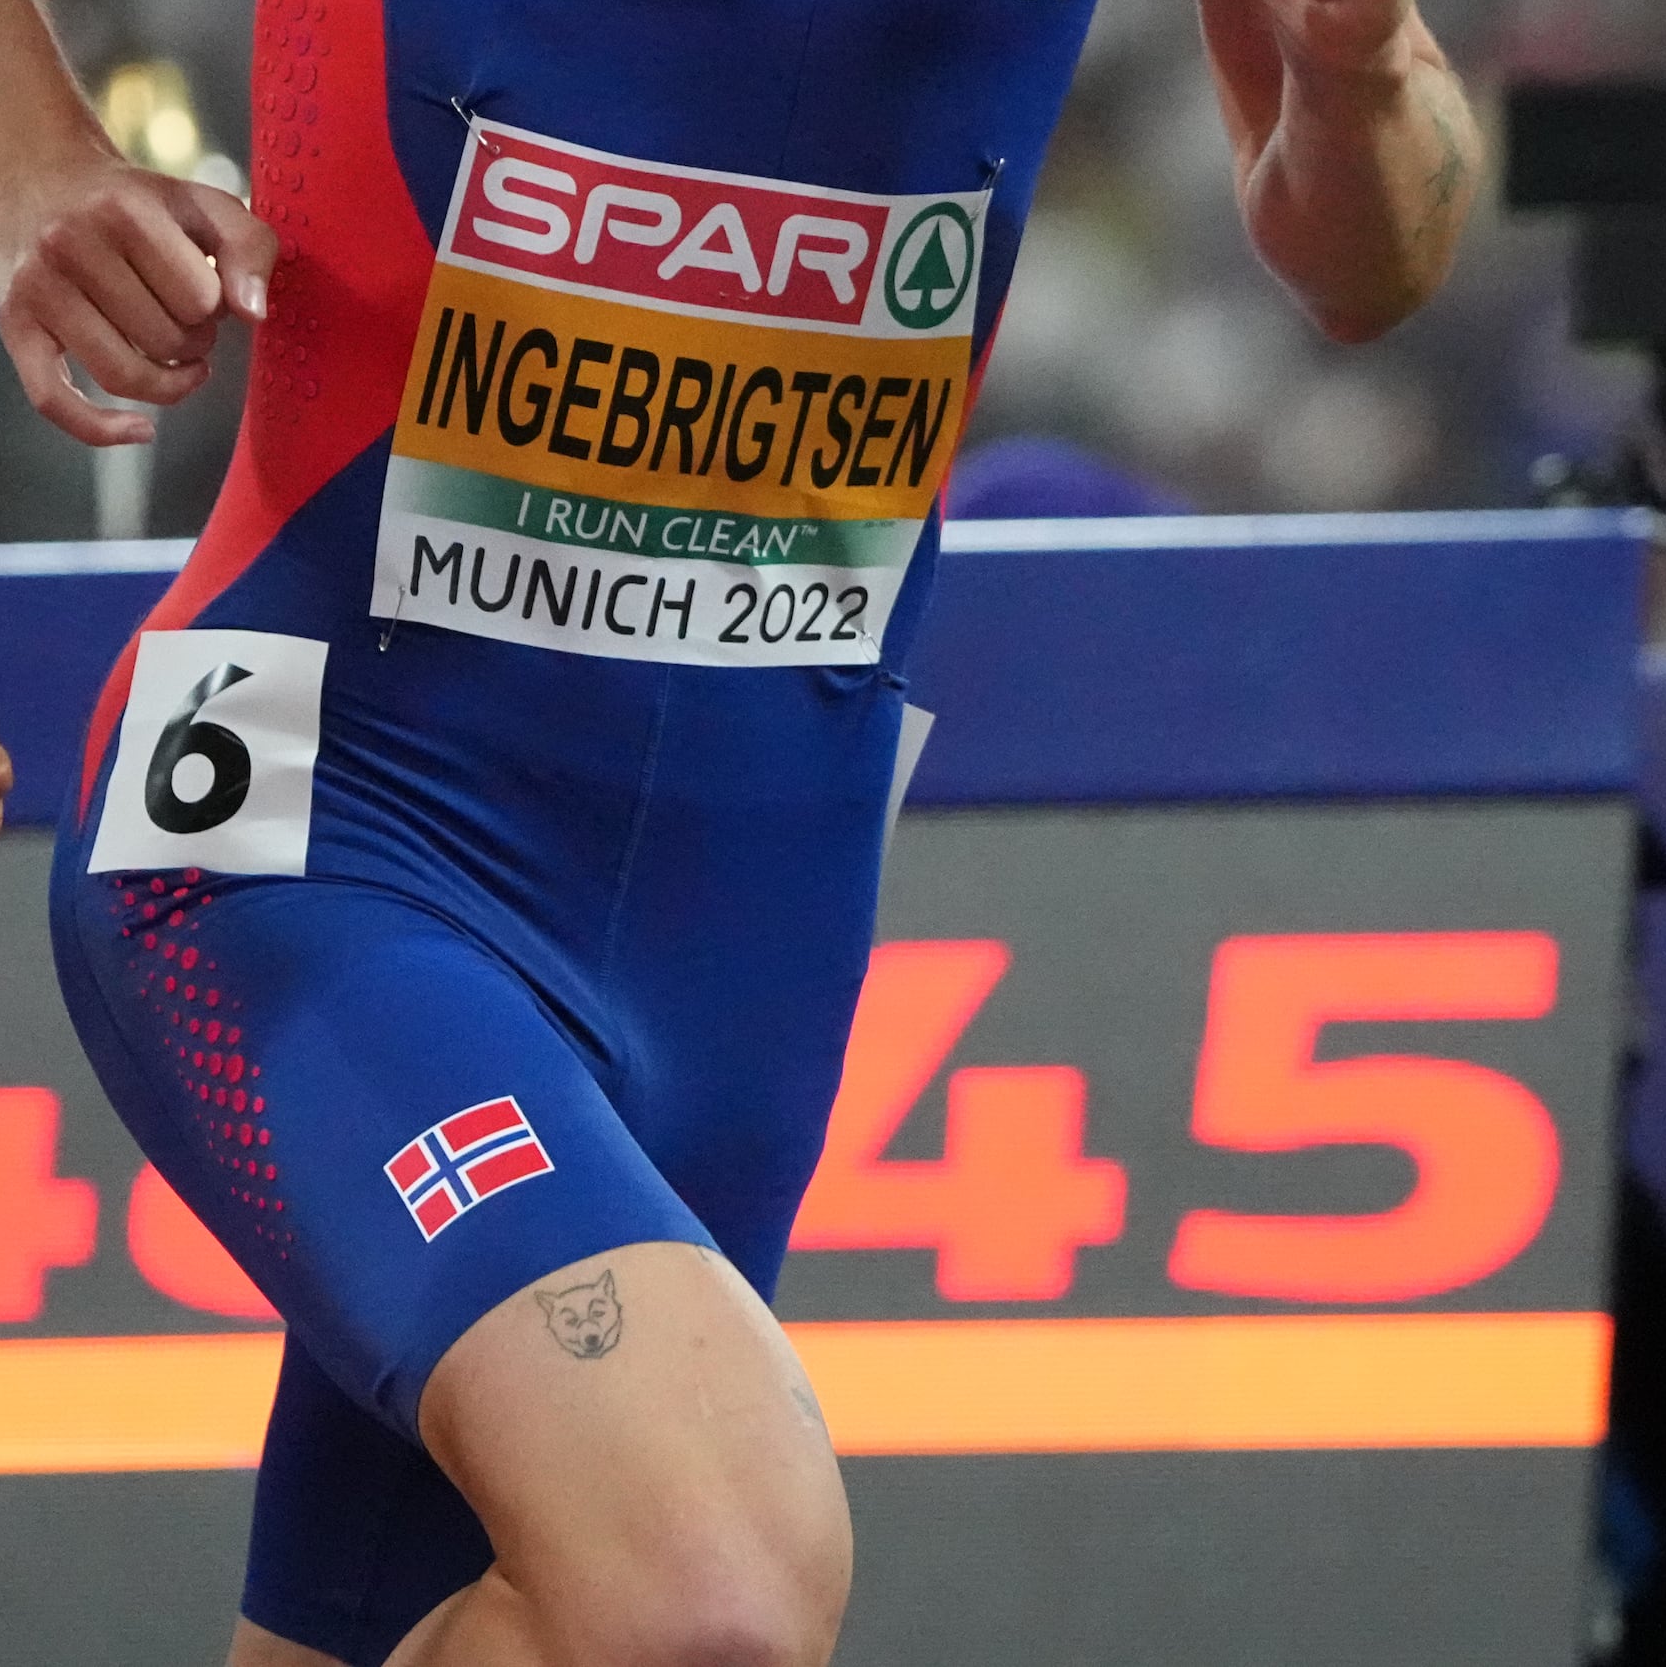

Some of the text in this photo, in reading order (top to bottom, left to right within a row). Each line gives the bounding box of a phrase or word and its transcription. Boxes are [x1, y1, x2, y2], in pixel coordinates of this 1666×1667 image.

[472, 156, 870, 305] SPAR
[416, 306, 953, 489] INGEBRIGTSEN
[409, 534, 870, 645] MUNICH 2022
[517, 491, 531, 527] I
[547, 499, 647, 550] RUN
[143, 660, 257, 835] 6
